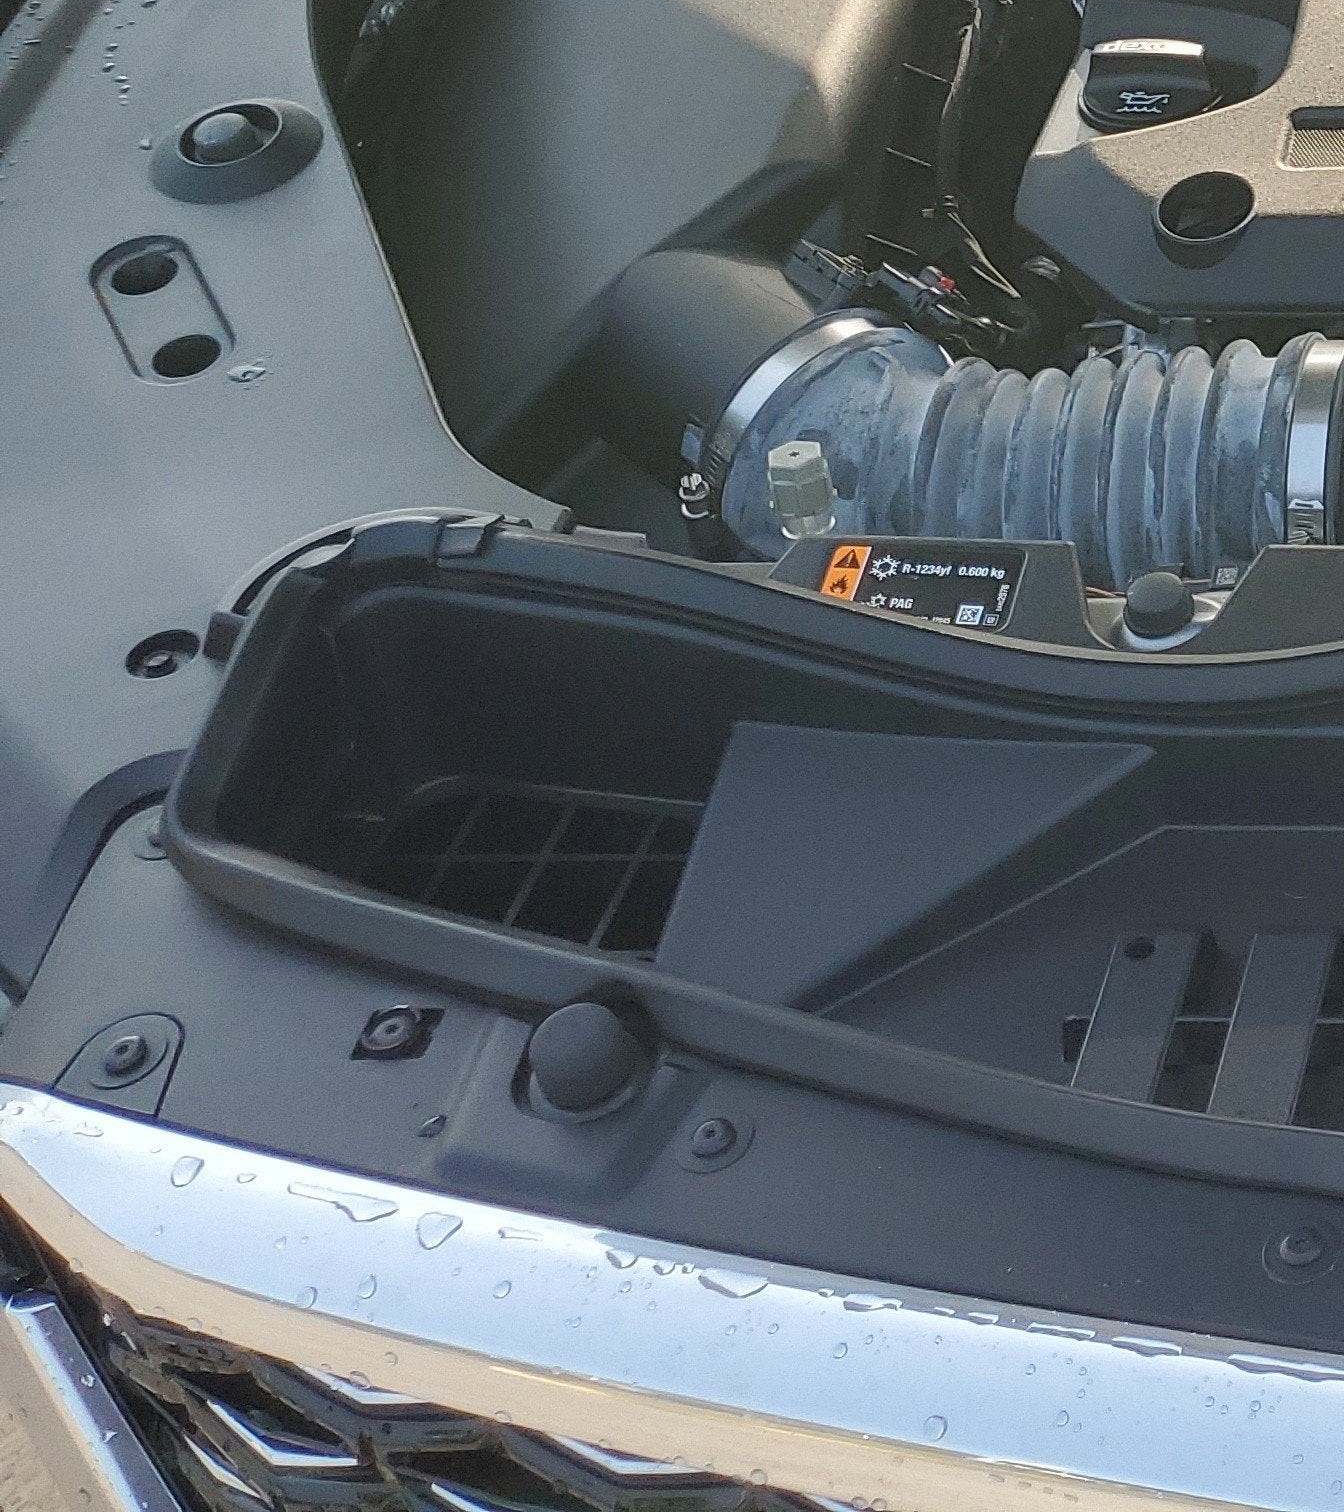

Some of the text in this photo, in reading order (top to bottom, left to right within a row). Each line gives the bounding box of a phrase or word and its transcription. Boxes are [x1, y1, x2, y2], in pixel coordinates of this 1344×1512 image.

[902, 564, 1006, 580] R-1234yf 0.600 kg
[889, 598, 913, 609] PAG
